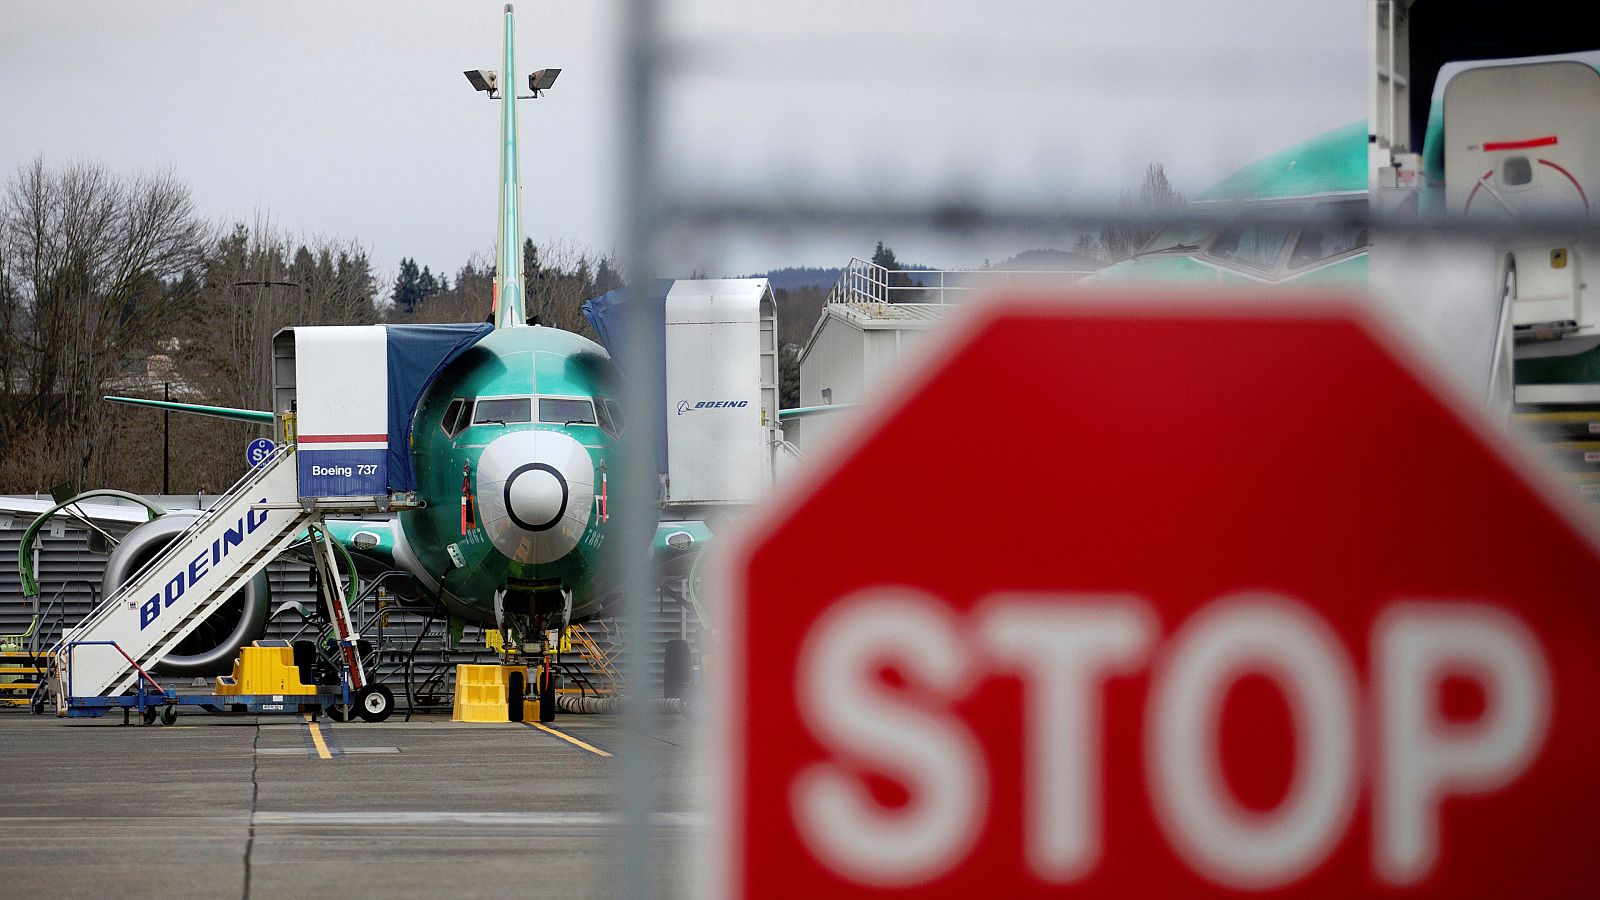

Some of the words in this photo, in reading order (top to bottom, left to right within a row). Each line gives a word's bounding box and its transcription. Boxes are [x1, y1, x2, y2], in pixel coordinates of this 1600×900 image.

[694, 400, 749, 409] BOEING
[258, 440, 266, 448] C
[312, 465, 352, 478] Boeing
[357, 464, 378, 475] 737
[140, 498, 270, 632] BOEING
[792, 588, 1551, 888] STOP
